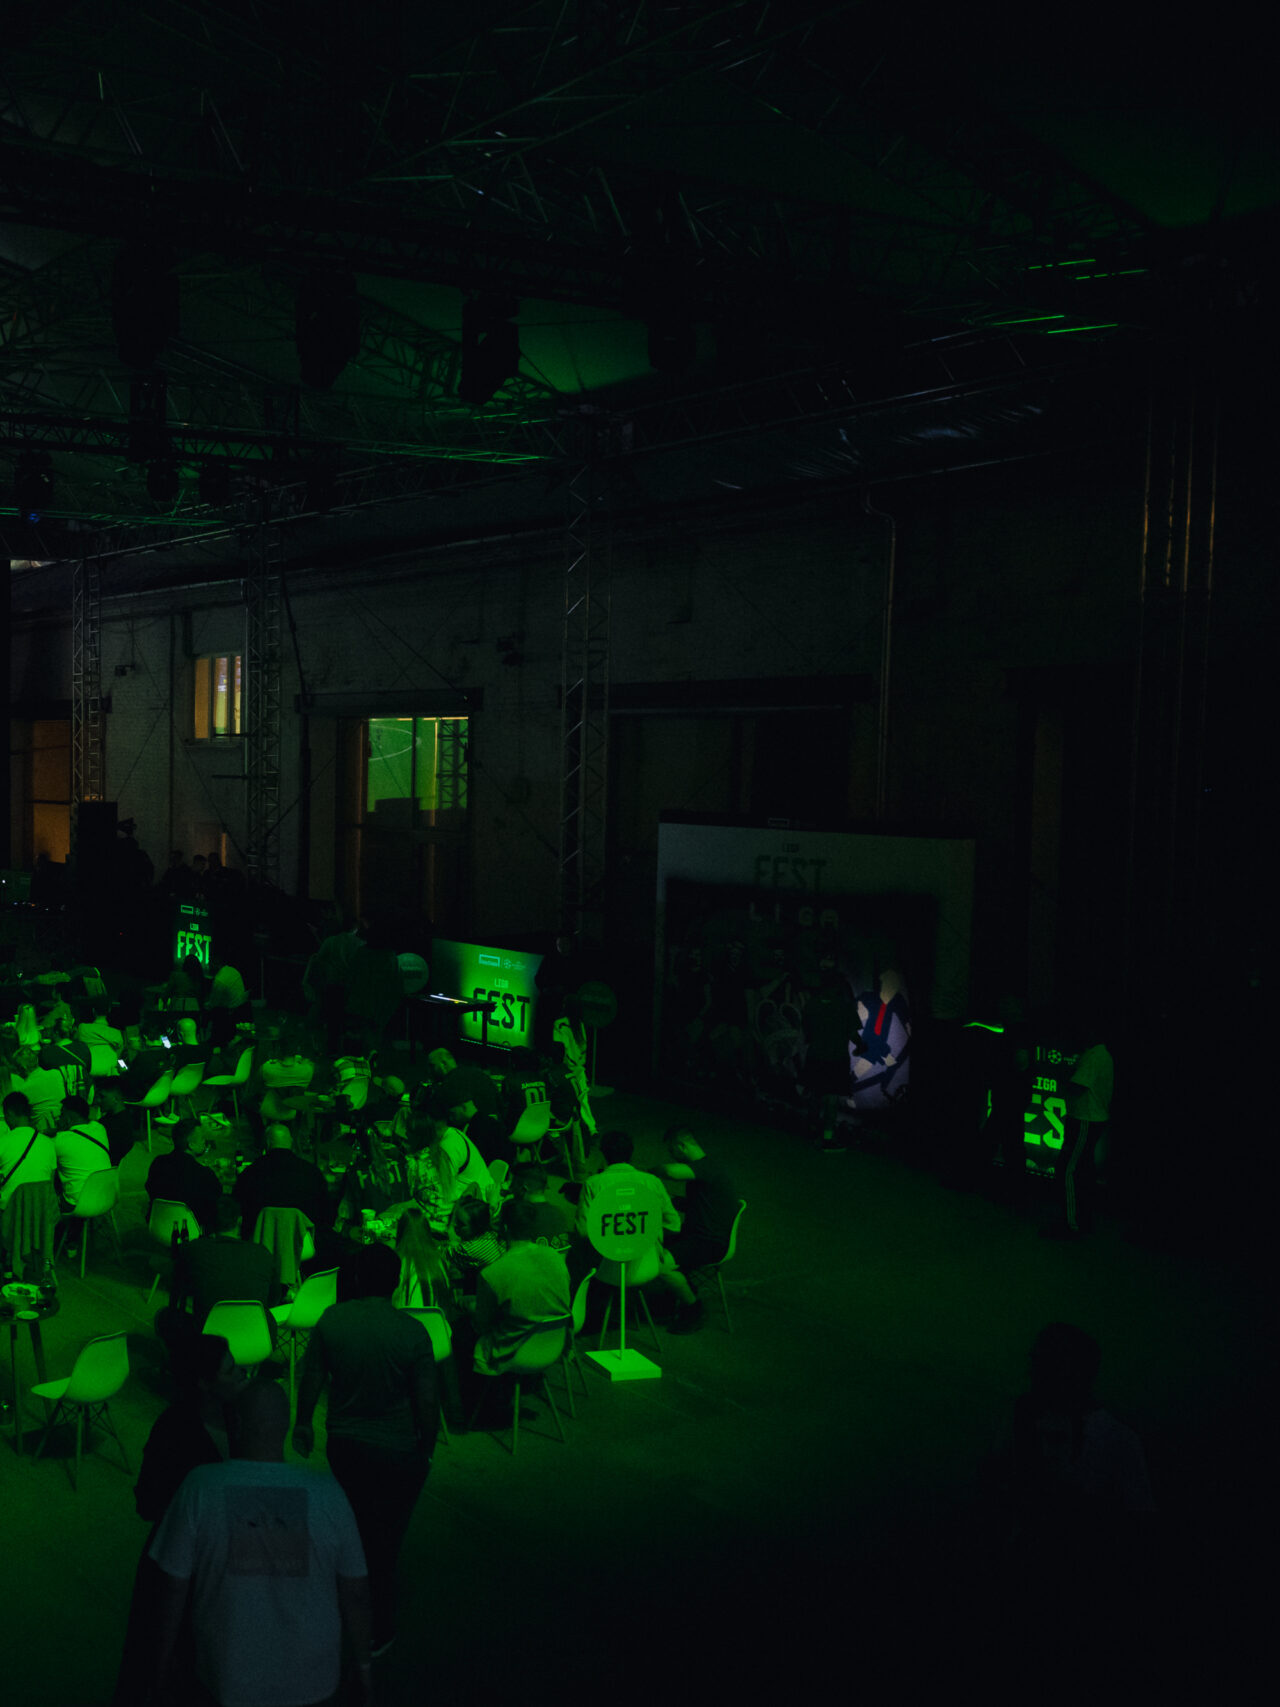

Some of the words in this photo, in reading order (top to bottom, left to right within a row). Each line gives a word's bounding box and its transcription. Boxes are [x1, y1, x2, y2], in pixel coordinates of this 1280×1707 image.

[754, 855, 827, 893] FEST
[177, 930, 212, 964] FEST
[473, 987, 531, 1033] FEST
[601, 1211, 649, 1237] FEST
